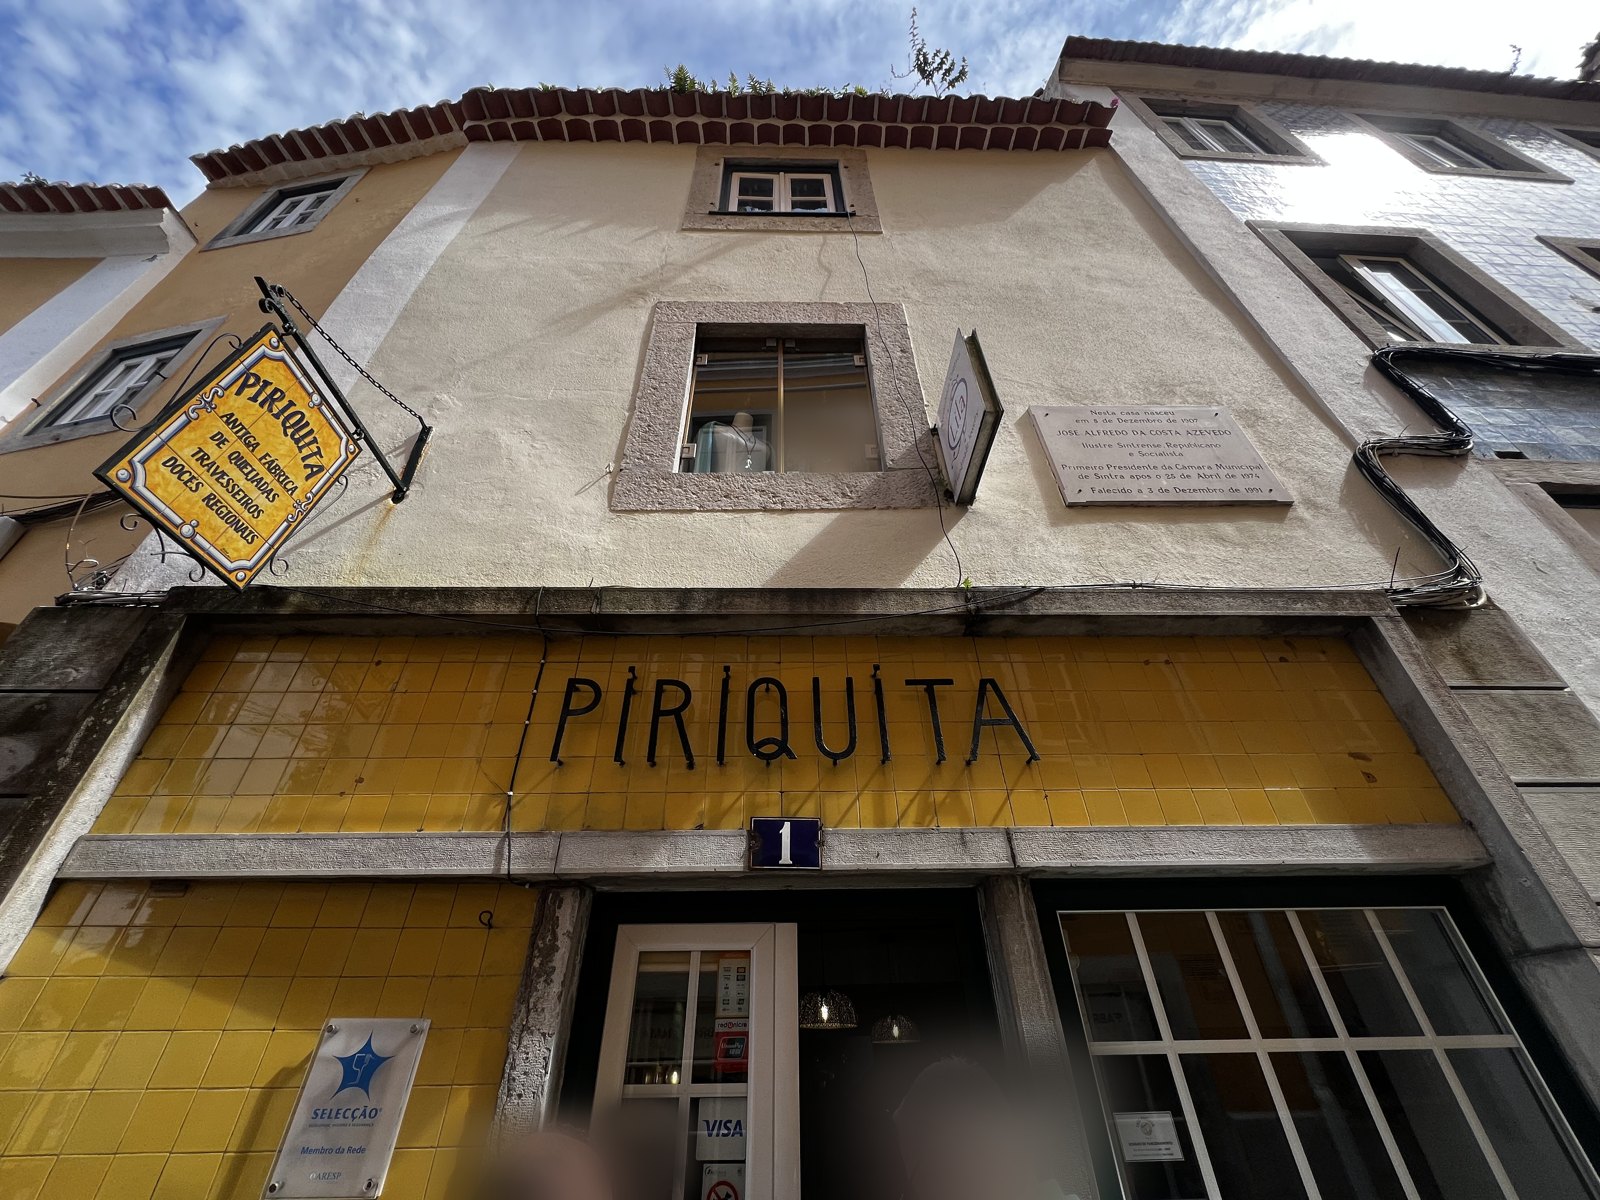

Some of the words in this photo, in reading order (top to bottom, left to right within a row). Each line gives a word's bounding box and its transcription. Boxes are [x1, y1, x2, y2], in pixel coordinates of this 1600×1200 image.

[220, 412, 261, 453] ANTIGA
[258, 452, 299, 497] FÁBRICA
[234, 371, 325, 482] PIRIQUITA
[161, 456, 204, 493] DOCES
[201, 492, 259, 545] REGIONAIS
[190, 446, 265, 520] TRAVESSEIROS
[209, 431, 230, 449] DE
[227, 450, 280, 503] QUEIJADAS
[550, 665, 1041, 768] PIRIQUITA
[777, 821, 793, 865] 1
[311, 1105, 379, 1122] SELECÇÃO
[702, 1119, 744, 1138] VISA
[300, 1146, 334, 1155] Membro
[335, 1146, 345, 1154] da
[346, 1146, 367, 1154] Rede
